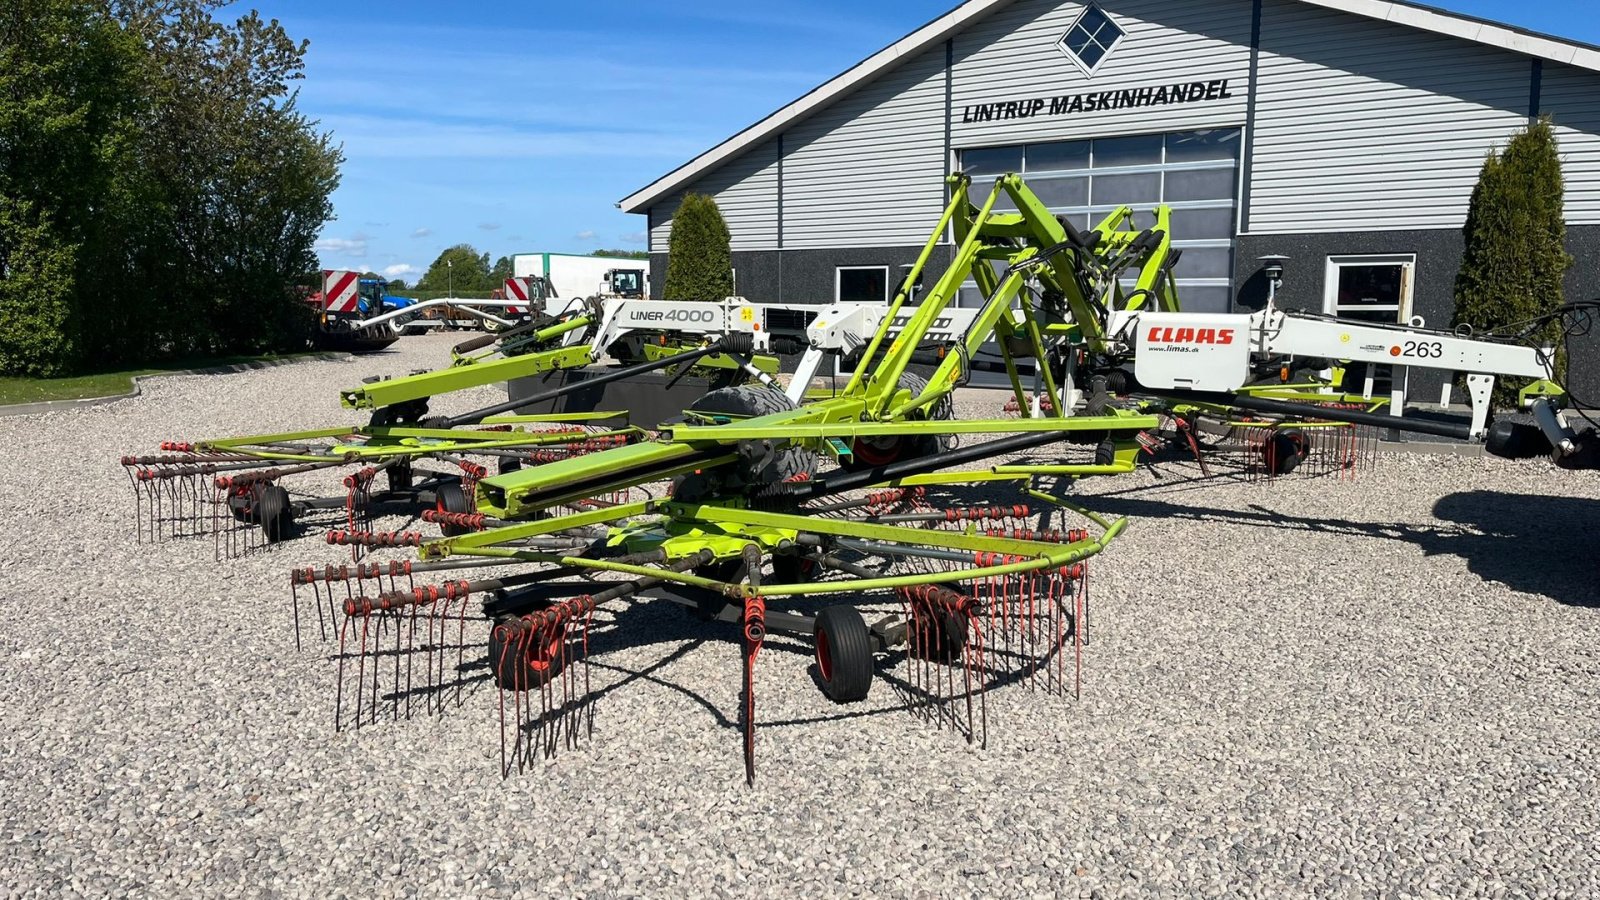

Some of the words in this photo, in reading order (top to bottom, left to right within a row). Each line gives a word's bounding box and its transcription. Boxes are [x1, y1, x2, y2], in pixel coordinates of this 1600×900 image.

[962, 99, 1045, 123] LINTRUP
[1049, 79, 1232, 115] MASKINHANDEL
[630, 310, 663, 321] LINER
[665, 309, 714, 322] 4000
[1147, 327, 1234, 345] CLAAS
[1148, 345, 1199, 353] www.limas.dk
[1402, 341, 1442, 358] 263
